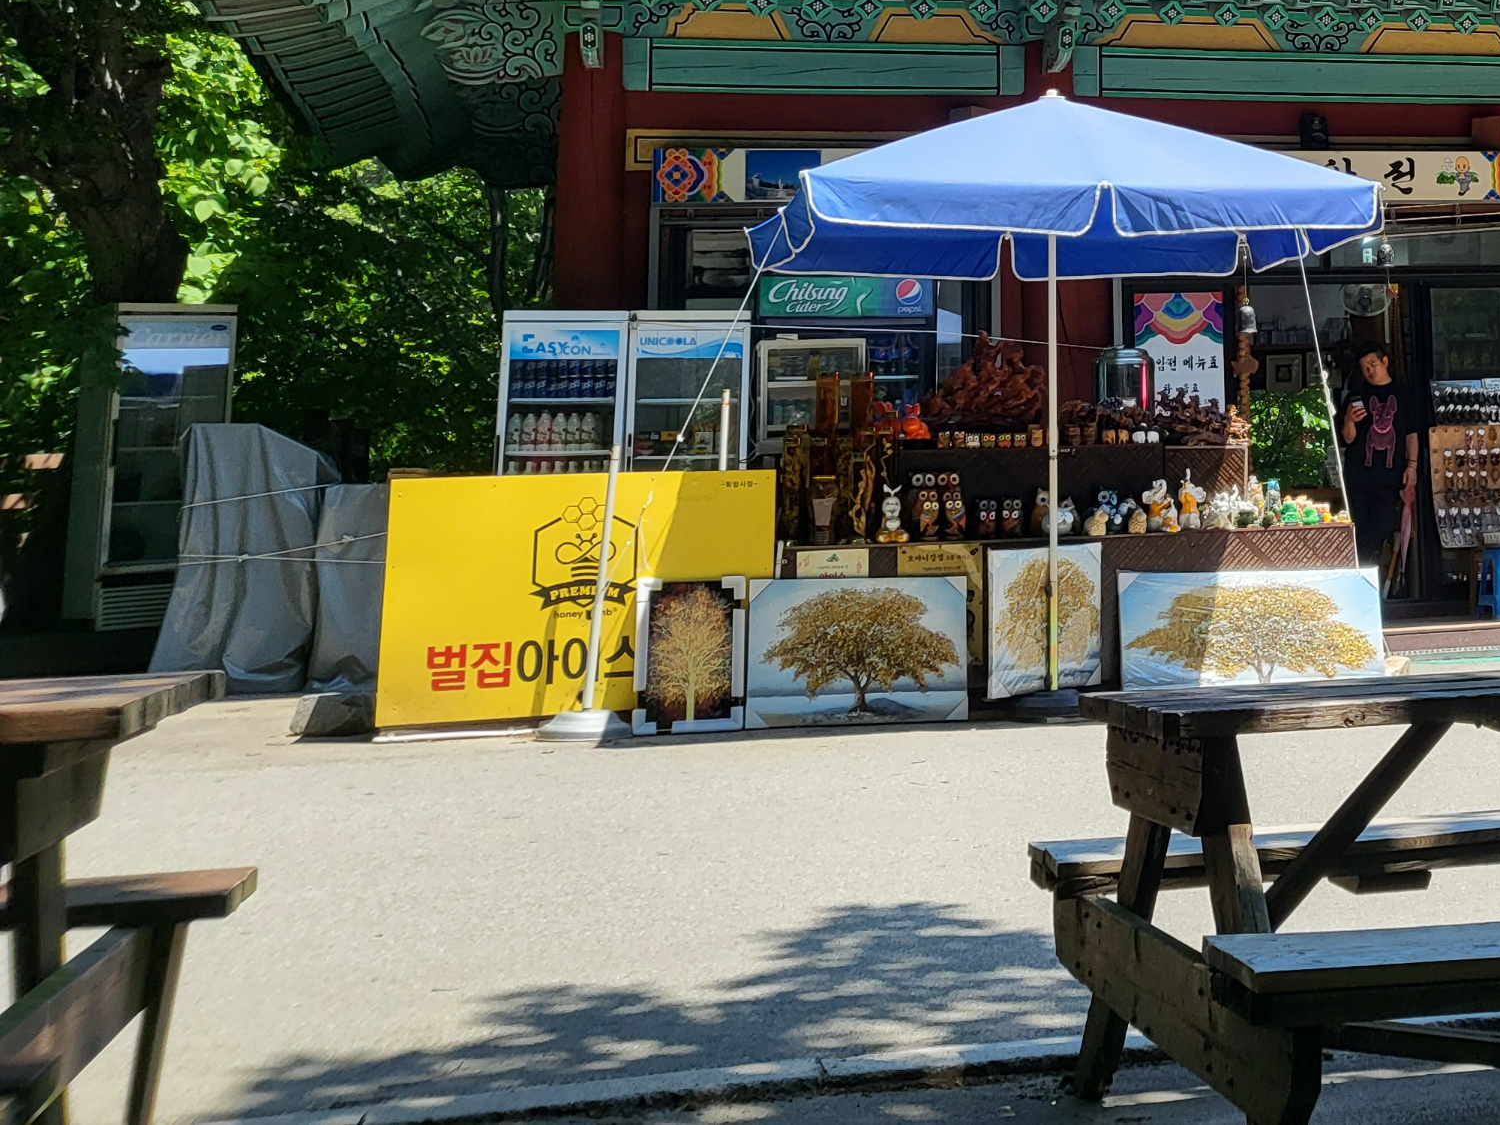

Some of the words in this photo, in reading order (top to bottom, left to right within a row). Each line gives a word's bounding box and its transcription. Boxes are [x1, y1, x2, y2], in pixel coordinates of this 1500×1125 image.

[768, 279, 849, 310] Chilsung
[897, 305, 922, 314] pepsi
[130, 327, 228, 346] Carrier
[1183, 355, 1219, 371] 메뉴표
[549, 585, 621, 600] PREMIM
[553, 609, 583, 620] honey
